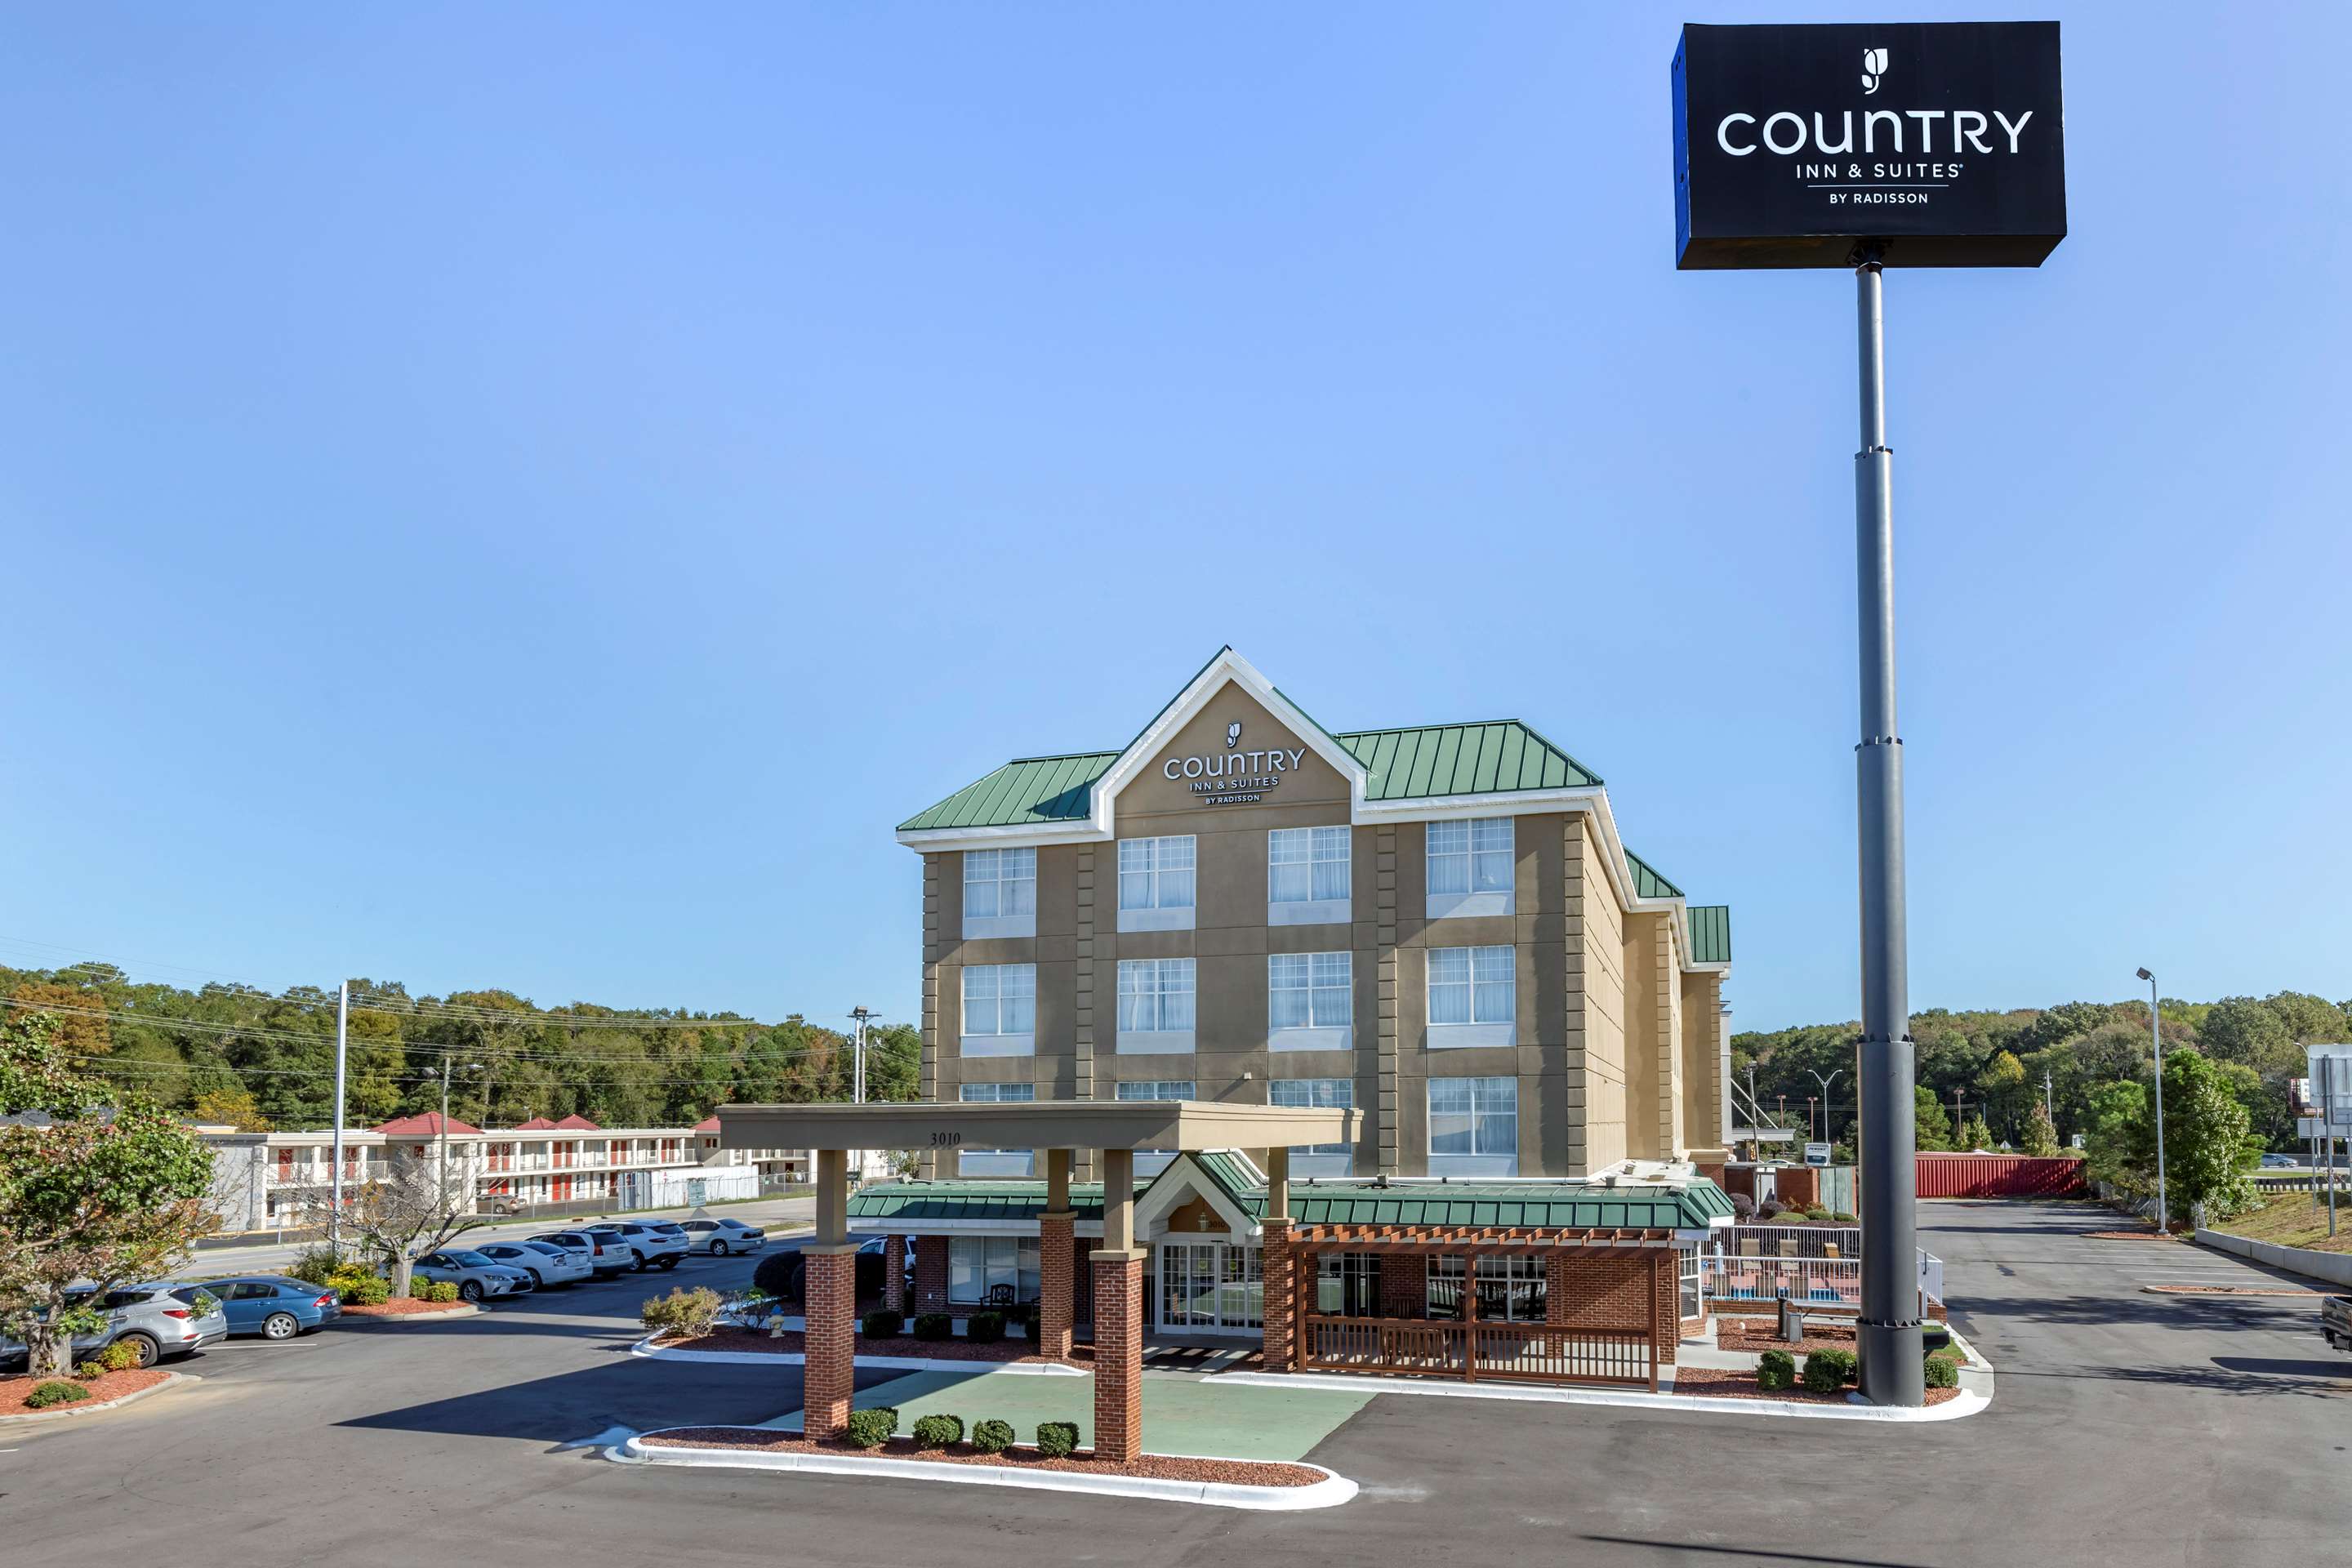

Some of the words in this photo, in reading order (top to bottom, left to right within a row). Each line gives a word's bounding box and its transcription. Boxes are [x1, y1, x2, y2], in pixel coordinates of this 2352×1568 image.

[1797, 164, 1837, 179] INN
[1848, 163, 1863, 178] &
[1873, 163, 1959, 178] SUITES
[1829, 194, 1847, 204] BY
[1853, 193, 1928, 204] RADISSON
[1189, 782, 1213, 791] INN
[1217, 781, 1226, 790] &
[1231, 777, 1280, 788] SUITES
[1218, 795, 1260, 804] RADISSON
[931, 1132, 960, 1145] 3010
